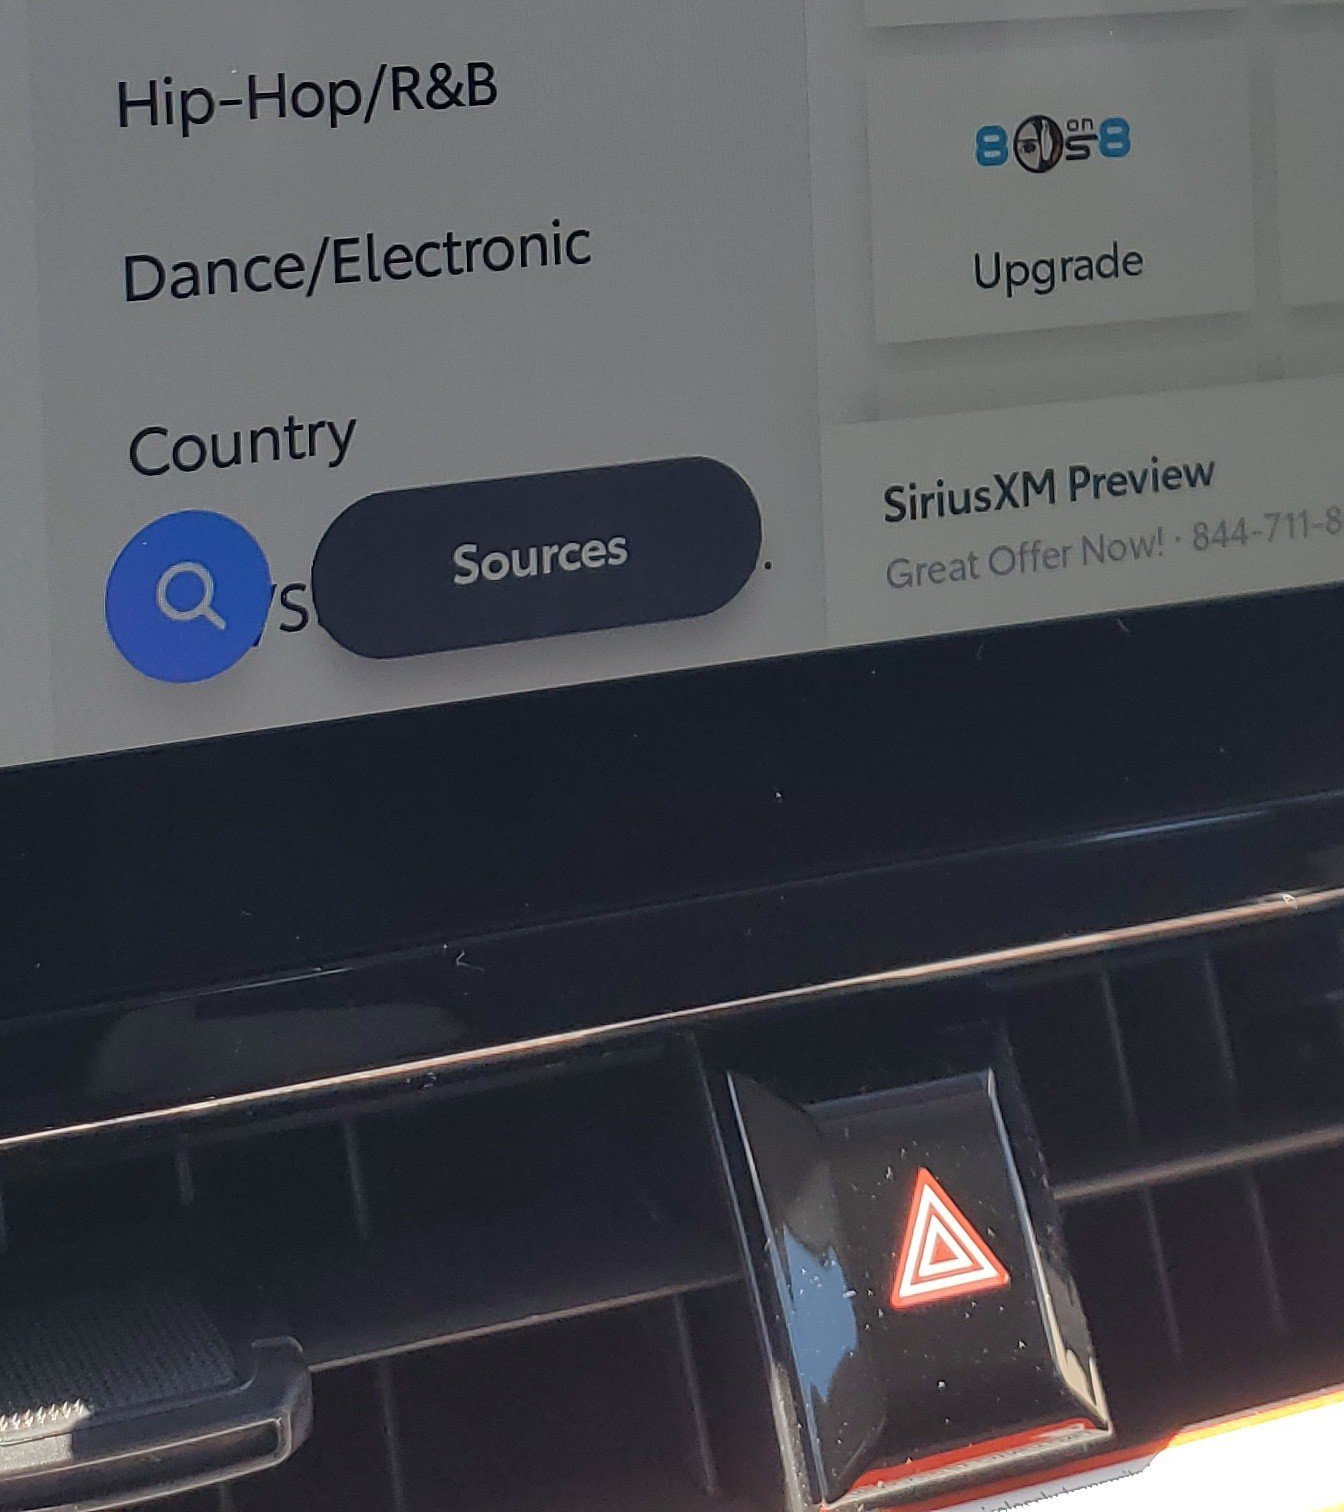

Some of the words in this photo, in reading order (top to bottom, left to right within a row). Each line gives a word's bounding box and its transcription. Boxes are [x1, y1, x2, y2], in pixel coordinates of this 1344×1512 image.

[116, 60, 499, 138] Hip-Hop/R&B
[123, 217, 593, 303] Dance/Electronic
[973, 240, 1145, 299] Upgrade
[127, 414, 358, 478] Country
[882, 468, 1057, 525] SiriusXM
[1067, 454, 1217, 505] Preview
[452, 536, 629, 586] Sources
[884, 550, 982, 591] Great
[986, 538, 1074, 578] Offer
[1080, 525, 1165, 567] Now!
